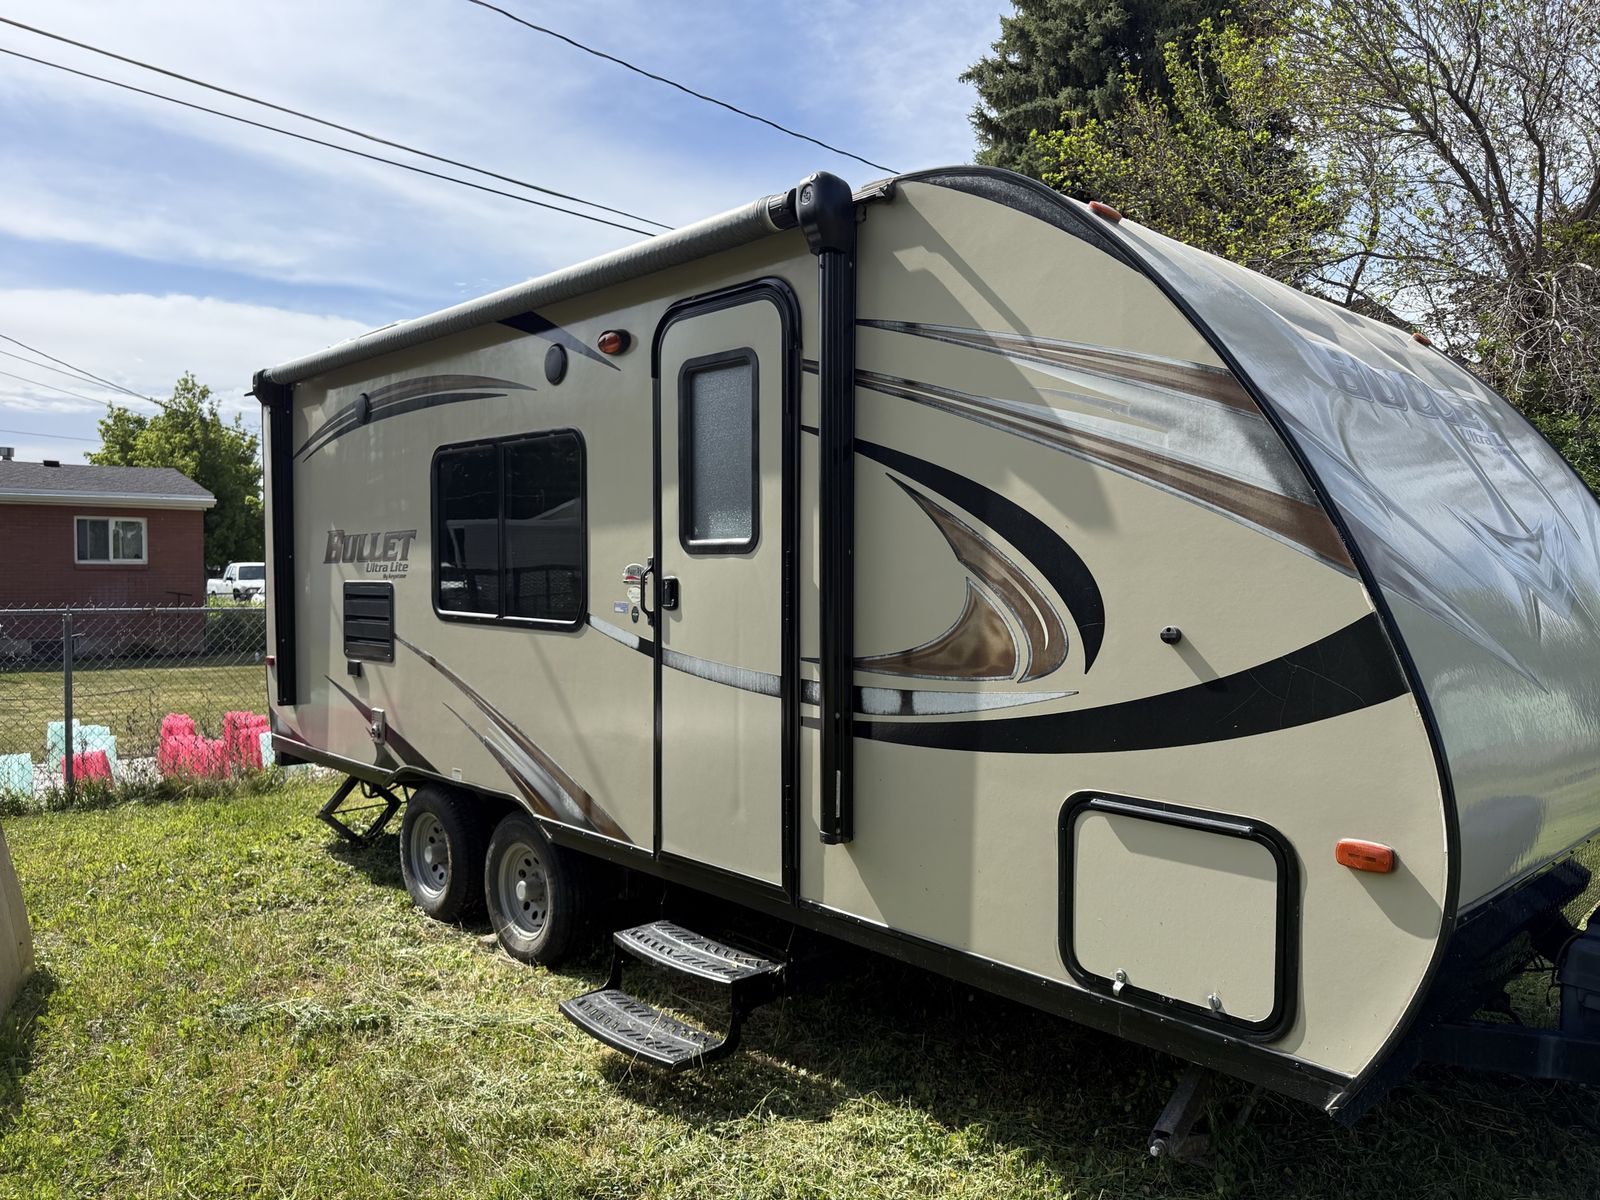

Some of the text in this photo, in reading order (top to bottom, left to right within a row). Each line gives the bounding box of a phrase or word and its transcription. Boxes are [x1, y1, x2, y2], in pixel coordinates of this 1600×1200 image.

[1459, 428, 1493, 446] Ultra
[323, 529, 417, 564] BULLET
[366, 561, 408, 572] Ultra Lite
